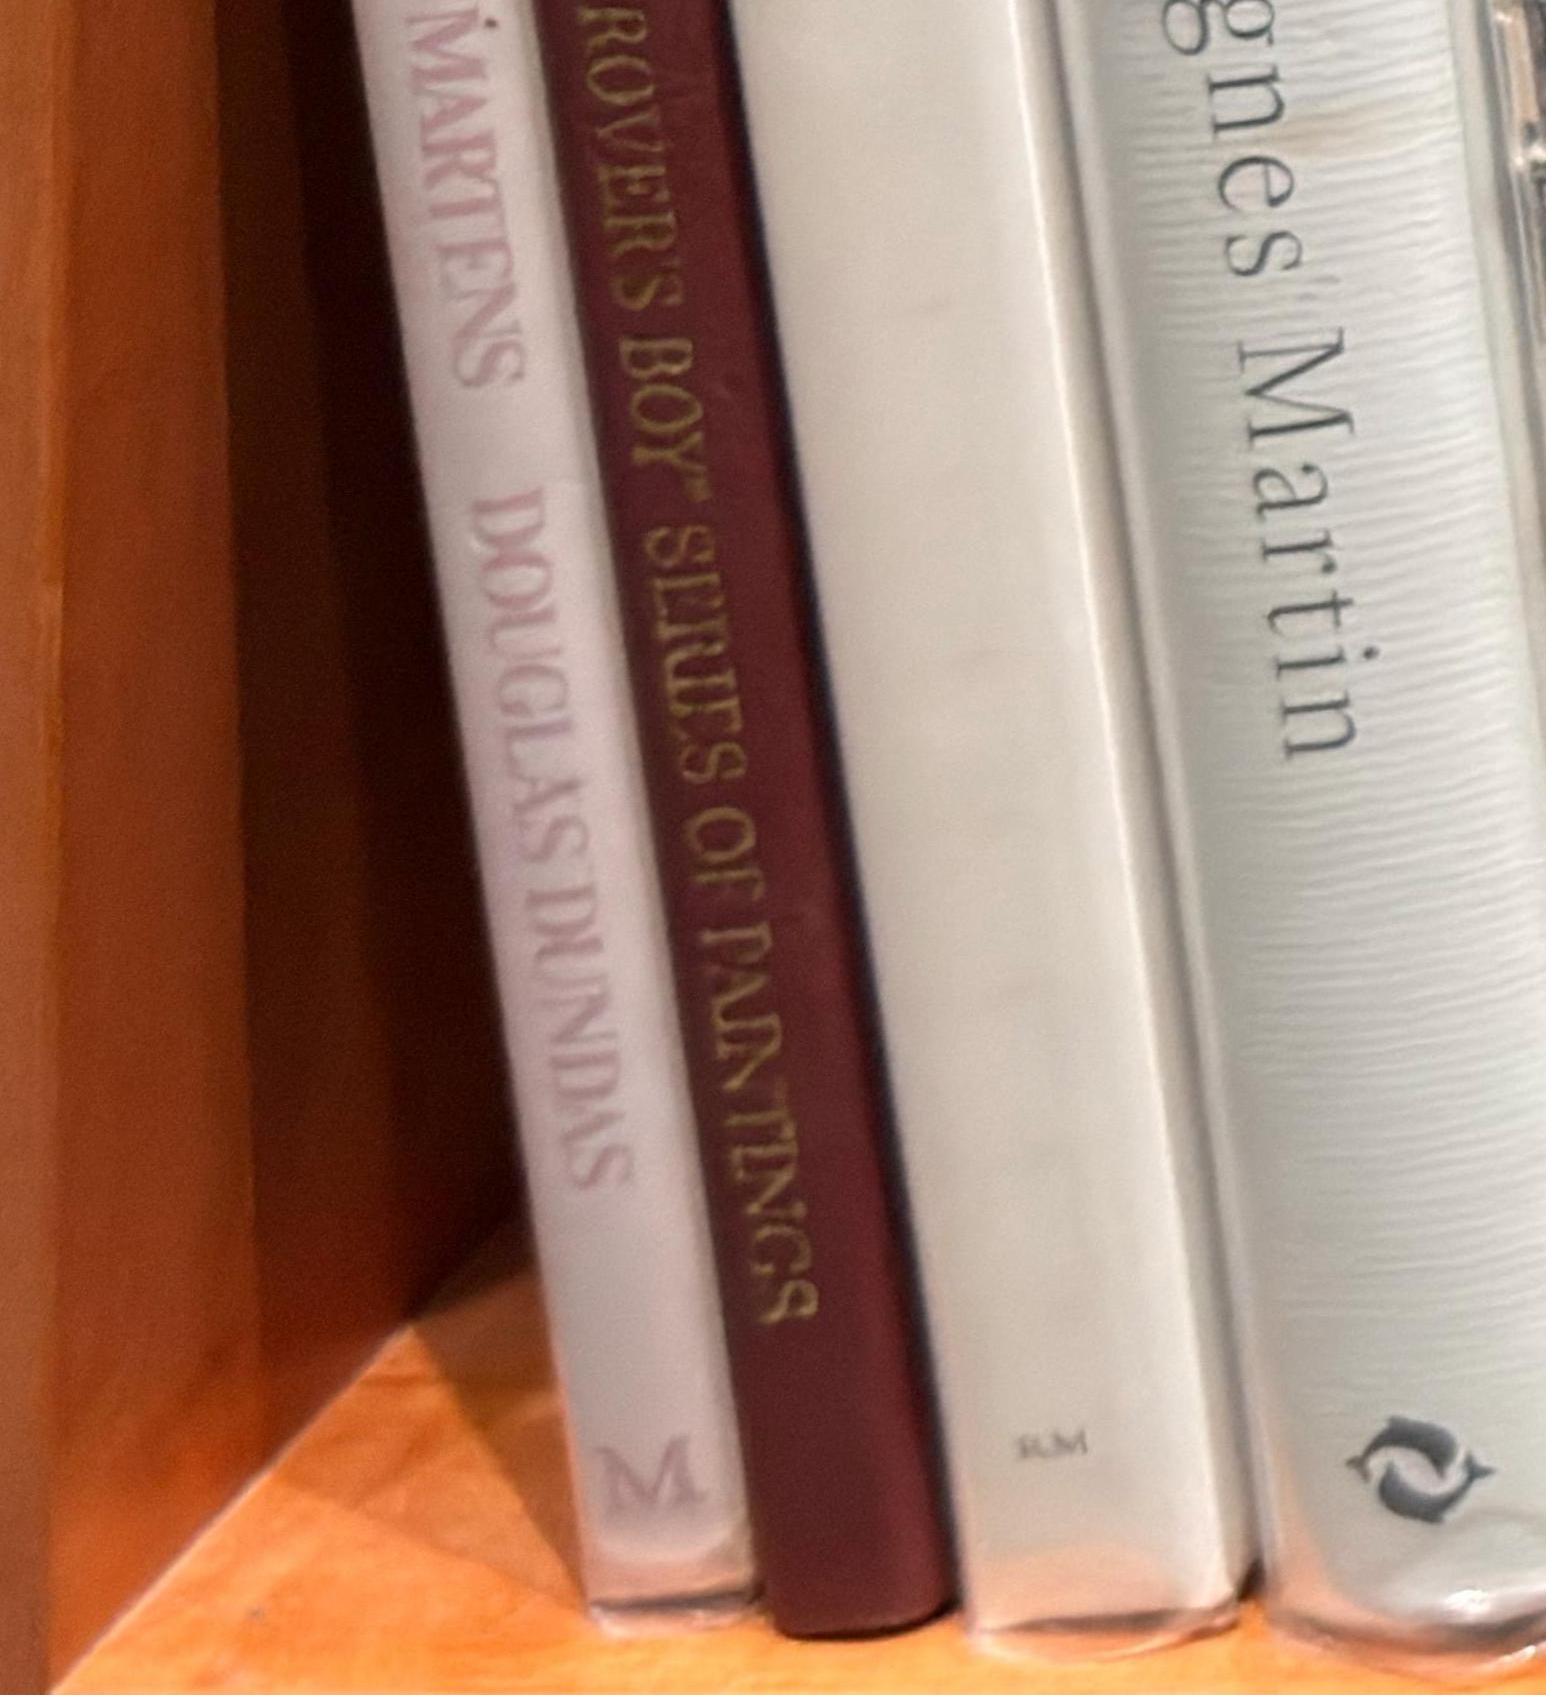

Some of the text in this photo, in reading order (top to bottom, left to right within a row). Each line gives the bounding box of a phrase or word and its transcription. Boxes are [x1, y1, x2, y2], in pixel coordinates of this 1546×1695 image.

[407, 3, 525, 389] MARTENS
[644, 524, 748, 786] SERIES
[1236, 327, 1381, 761] Martin
[471, 486, 632, 1193] DOUGLAS DUNDAS
[682, 805, 765, 913] OF
[698, 918, 818, 1327] PAINTINGS
